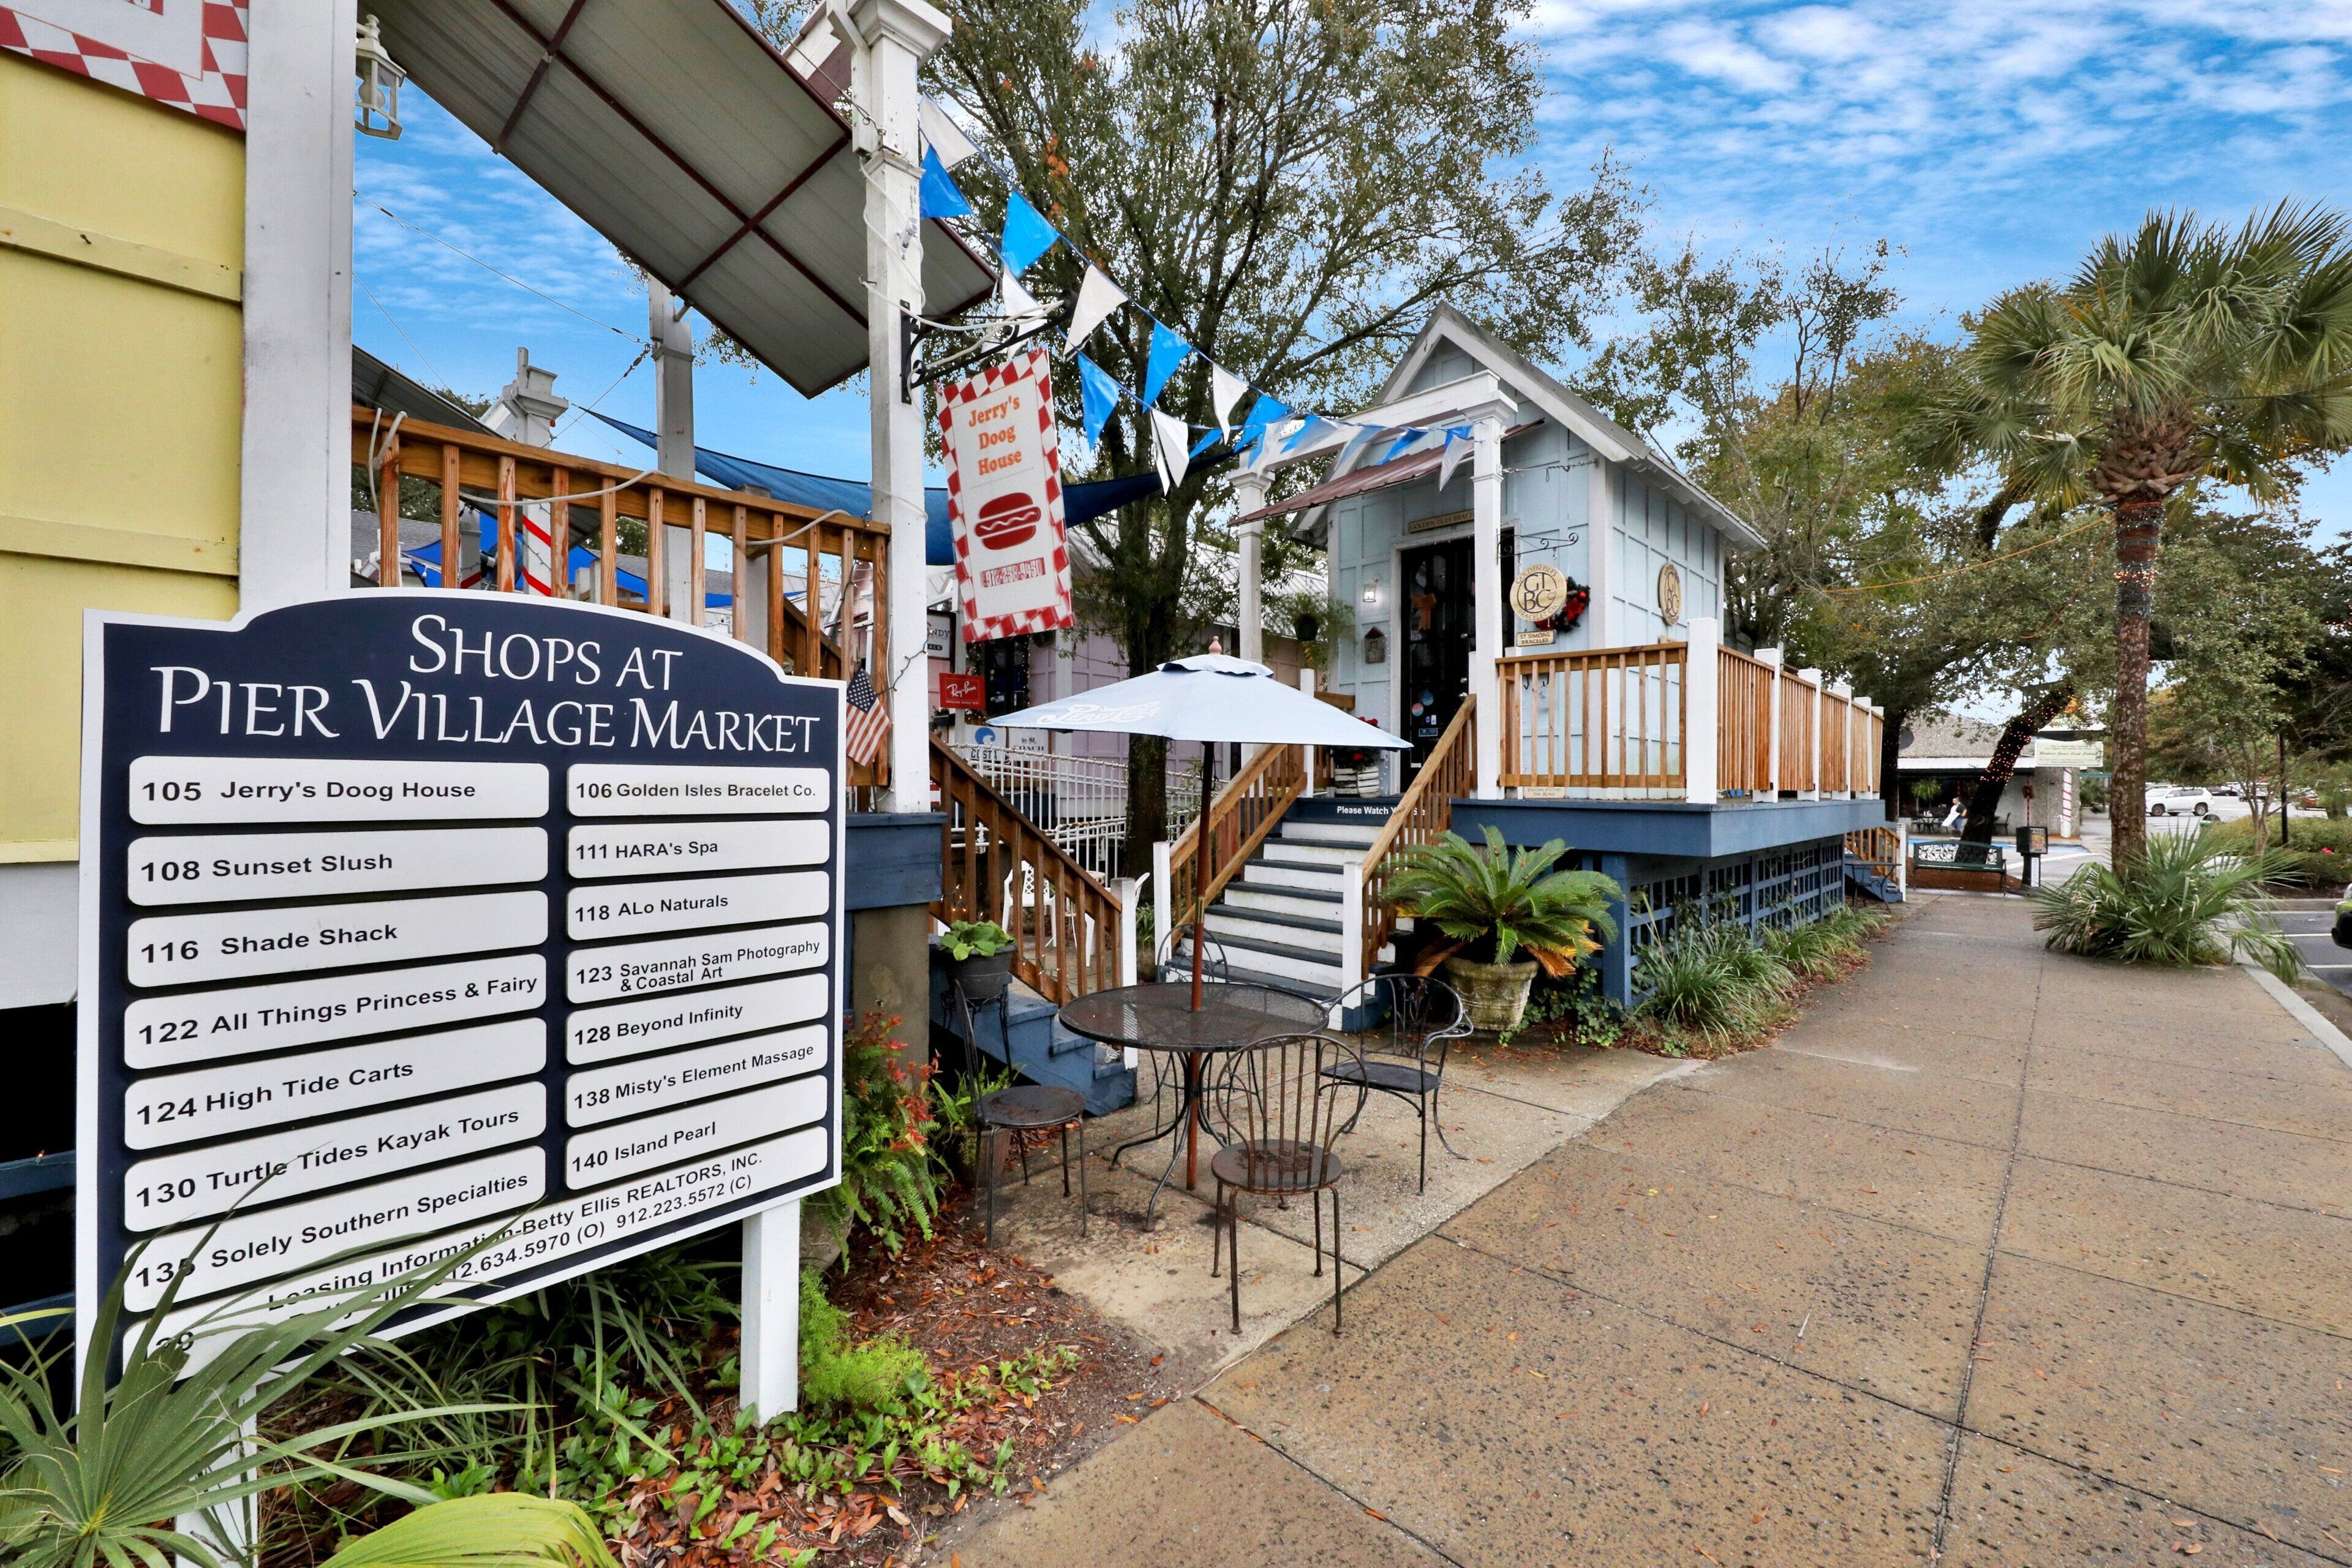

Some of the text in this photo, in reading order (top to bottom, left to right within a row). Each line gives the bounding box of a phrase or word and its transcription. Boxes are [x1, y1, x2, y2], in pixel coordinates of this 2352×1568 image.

[968, 395, 1020, 427] Jerry's
[978, 425, 1016, 450] Doog
[978, 451, 1022, 476] House
[1516, 565, 1542, 584] GOLDEN
[410, 614, 684, 690] SHOPS AT
[150, 666, 820, 753] PIER VILLAGE MARKET
[143, 782, 475, 802] 105 Jerry's Doog House
[576, 783, 816, 798] 106 Golden Isles Bracelet Co.
[1336, 805, 1362, 815] Please
[1363, 805, 1389, 815] Watch
[141, 854, 392, 882] 108 Sunset Slush
[576, 841, 718, 860] 111 HARA's Spa
[575, 895, 728, 922] 118 ALo Naturals
[141, 924, 398, 963] 116 Shade Shack
[576, 941, 820, 984] 123 Savannah Sam Photography
[620, 966, 723, 992] & Coastal Art
[139, 977, 537, 1044] 122 All Things Princess & Fairy
[575, 1005, 743, 1046] 128 Beyond Infinity
[137, 1063, 413, 1125] 124 High Tide Carts
[574, 1046, 813, 1109] 138 Misty's Element Massage
[137, 1112, 519, 1207] 130 Turtle Tides Kayak Tours
[572, 1121, 715, 1172] 140 Island Pearl
[581, 1197, 620, 1218] Ellis
[627, 1164, 726, 1204] REALTORS,
[731, 1153, 763, 1172] INC.
[211, 1236, 292, 1267] Solely
[301, 1206, 409, 1244] Southern
[417, 1175, 528, 1213] Specialties
[578, 1221, 605, 1244] (O)
[617, 1183, 725, 1229] 912.223.5572
[730, 1175, 751, 1194] (C)
